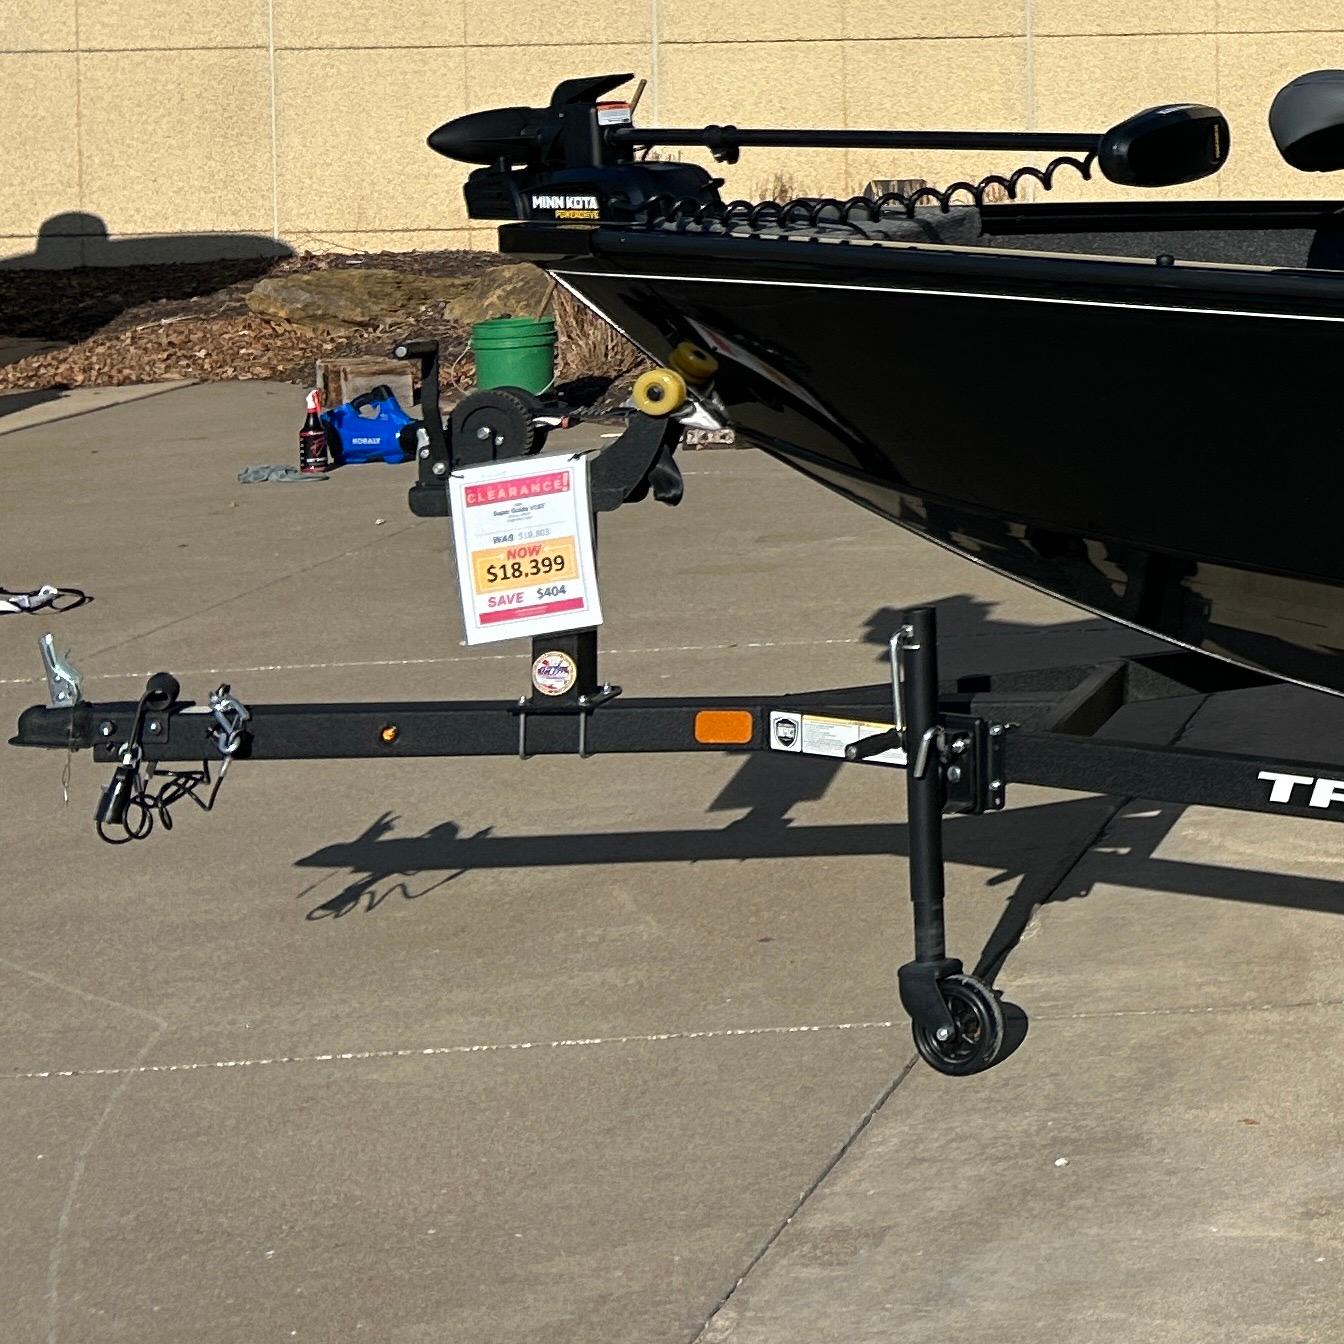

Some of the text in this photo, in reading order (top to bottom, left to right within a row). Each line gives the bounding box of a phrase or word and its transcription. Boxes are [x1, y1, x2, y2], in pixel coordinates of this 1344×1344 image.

[532, 195, 599, 209] MINN KOTA
[466, 471, 570, 505] CLEARANCE!
[506, 544, 542, 560] NOW
[488, 584, 567, 608] SAVE $404
